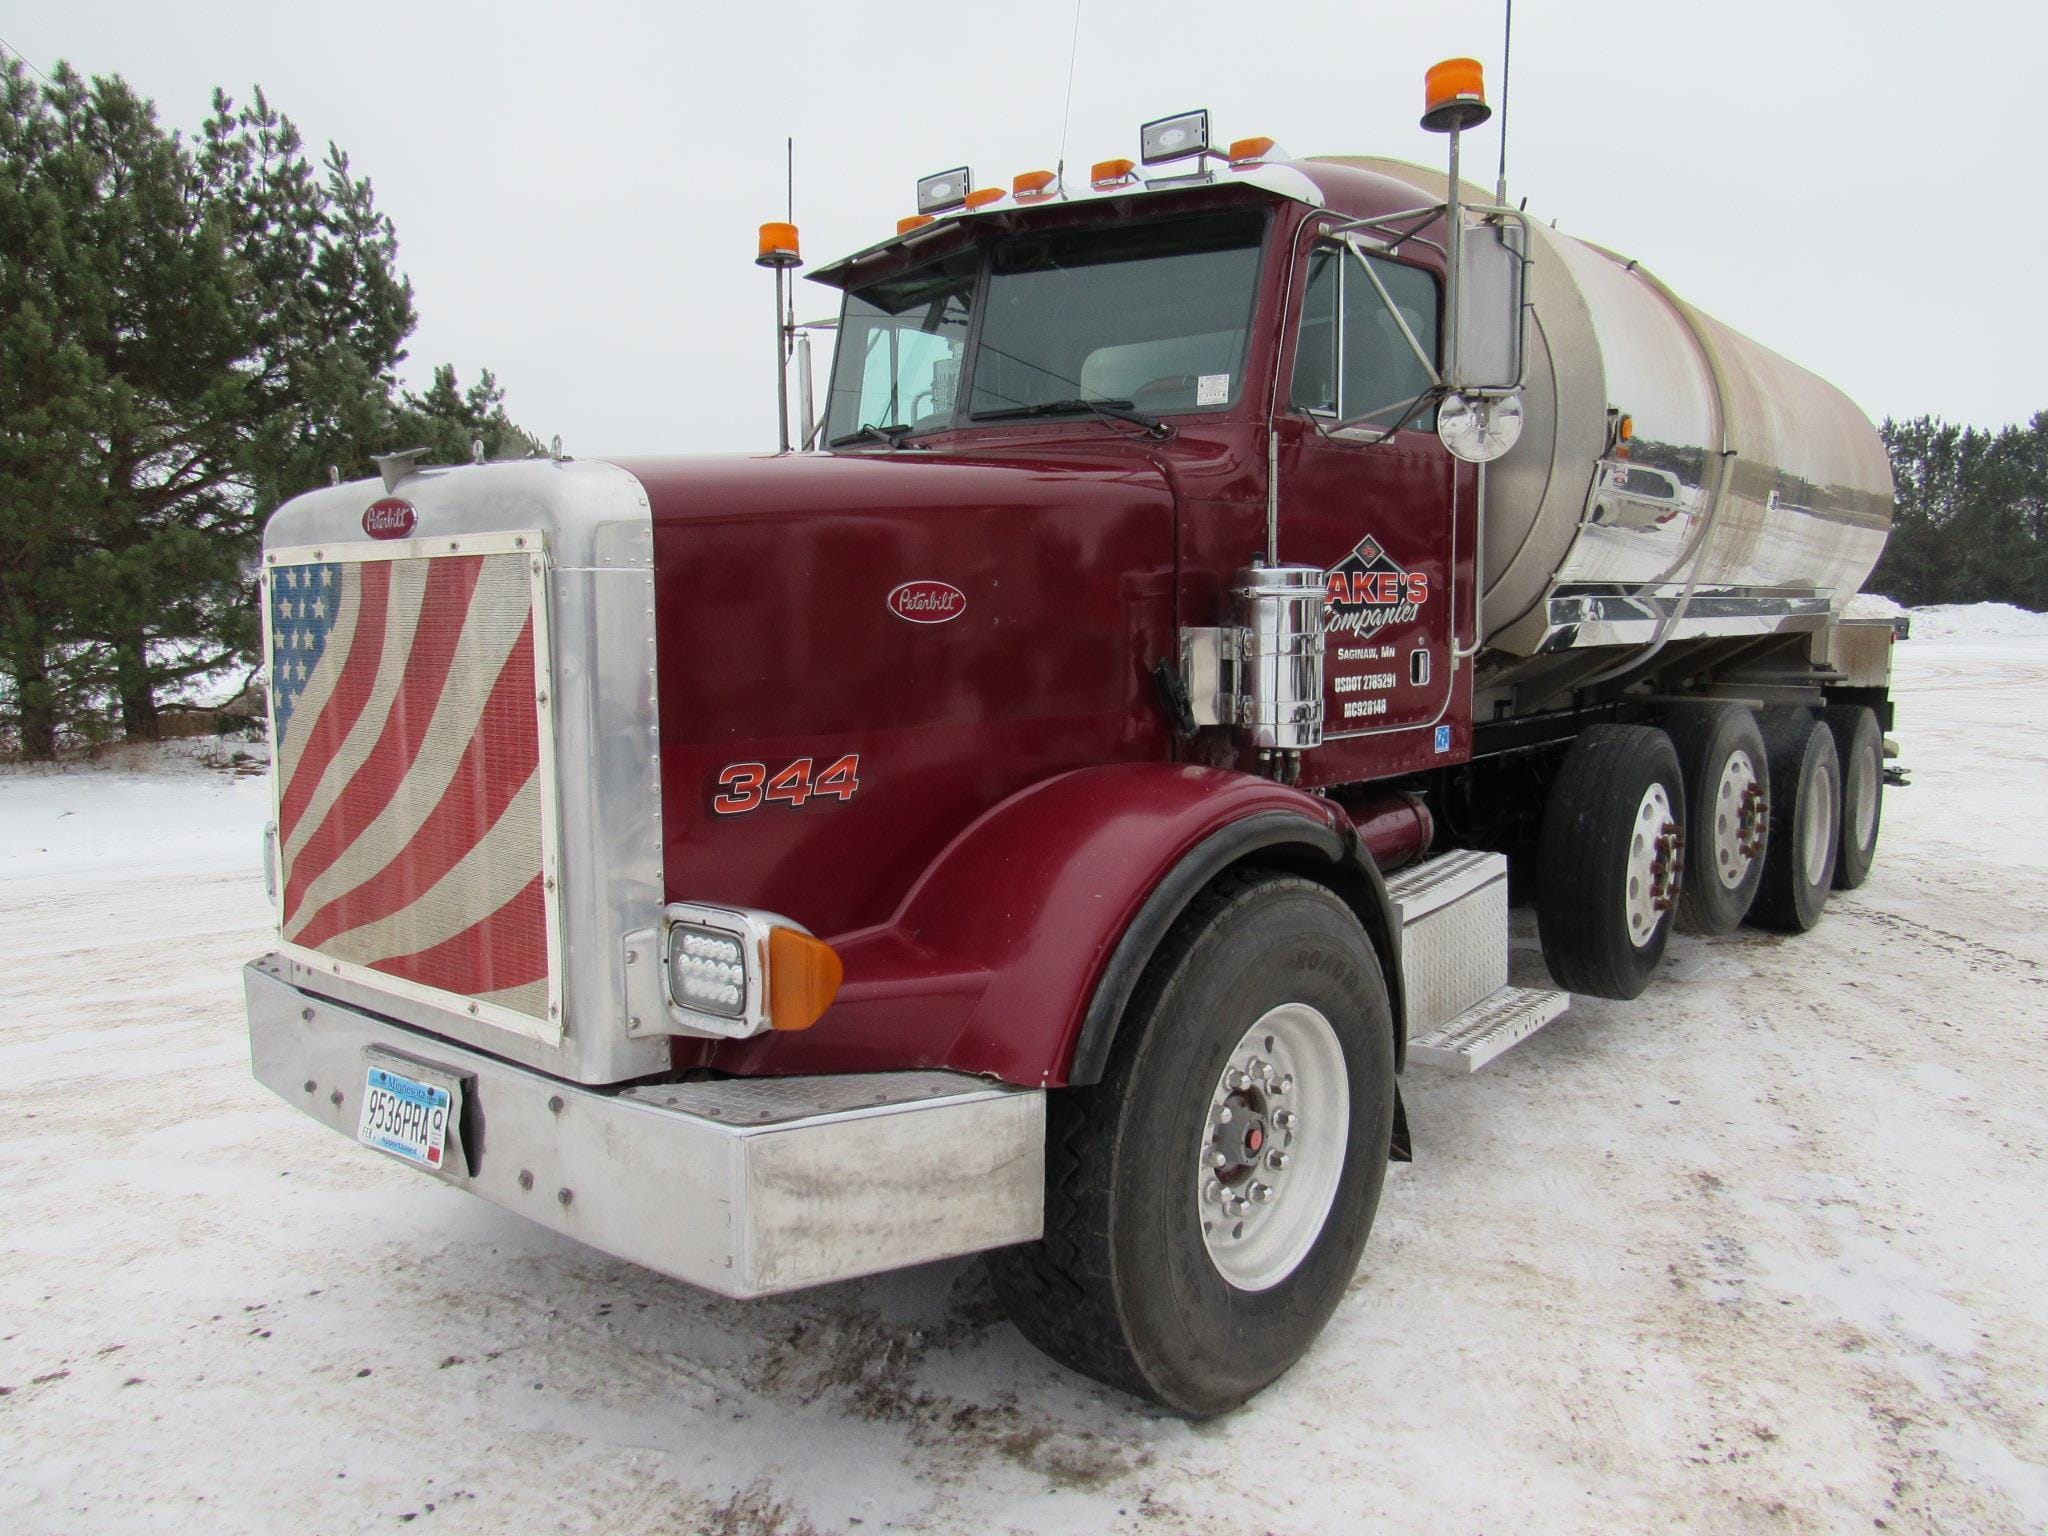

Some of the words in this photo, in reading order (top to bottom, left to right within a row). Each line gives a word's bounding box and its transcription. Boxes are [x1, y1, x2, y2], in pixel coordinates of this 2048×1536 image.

[367, 507, 409, 532] Peterbilt
[899, 588, 959, 612] Peterbilt
[1324, 572, 1428, 604] AKE'S
[1335, 676, 1362, 693] USDOT
[1363, 673, 1396, 690] 2785291
[1344, 699, 1387, 718] MC928148
[714, 754, 860, 814] 344
[388, 1076, 426, 1098] Minnesota
[368, 1089, 429, 1146] 9536PRA
